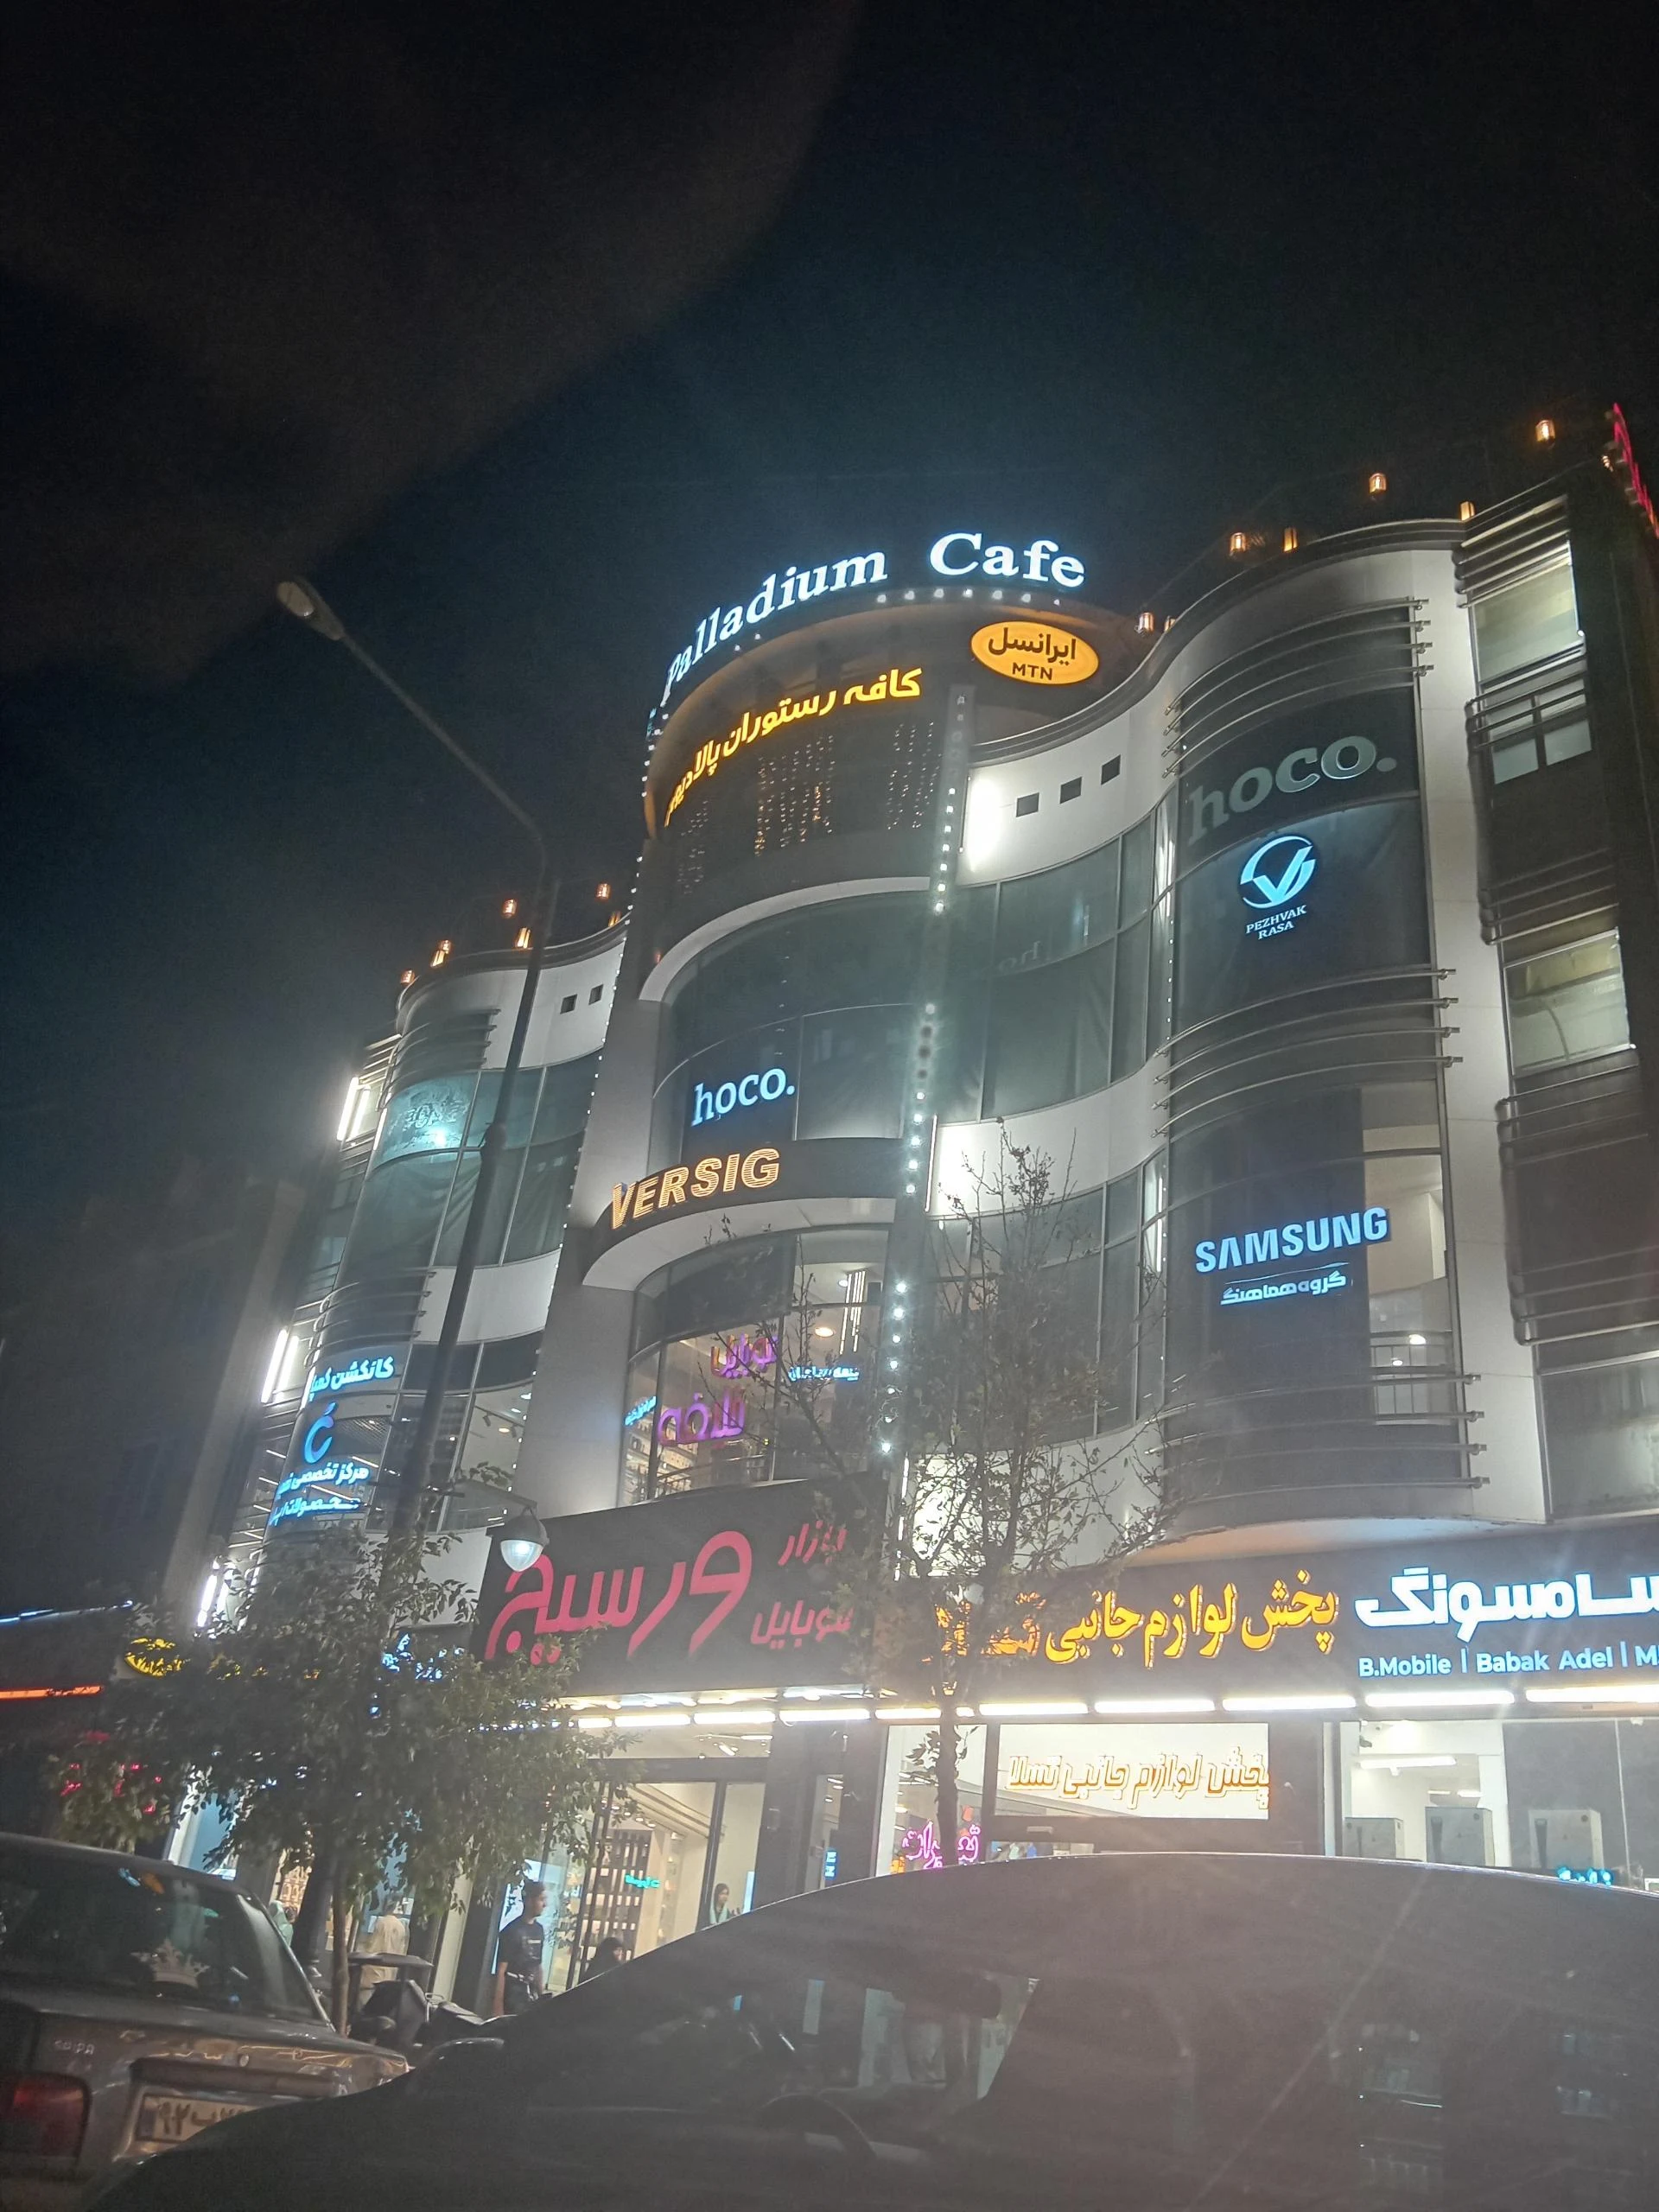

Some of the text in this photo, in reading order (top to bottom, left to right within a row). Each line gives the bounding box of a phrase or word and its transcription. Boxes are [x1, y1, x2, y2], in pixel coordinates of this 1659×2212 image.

[660, 531, 1086, 707] Palladium Cafe
[988, 626, 1077, 668] ایرانسل
[842, 668, 923, 705] کافه
[1012, 662, 1053, 681] MTN
[722, 688, 836, 757] رستوران
[1186, 735, 1397, 846] hoco.
[1245, 905, 1307, 934] PEZHVAK
[1258, 920, 1294, 940] RASA
[691, 1068, 796, 1127] hoco.
[611, 1147, 780, 1230] VERSIG
[1195, 1206, 1389, 1273] SAMSUNG
[1220, 1269, 1347, 1306] گروه هماهنگ
[331, 1356, 395, 1390] کانکشن
[290, 1461, 340, 1491] تخصصی
[335, 1461, 370, 1486] مرکز
[1045, 1589, 1143, 1666] جانبی
[1143, 1582, 1237, 1669] لوازم
[1241, 1568, 1340, 1655] پخش
[1358, 1644, 1659, 1677] B.Mobile Babak Adel M
